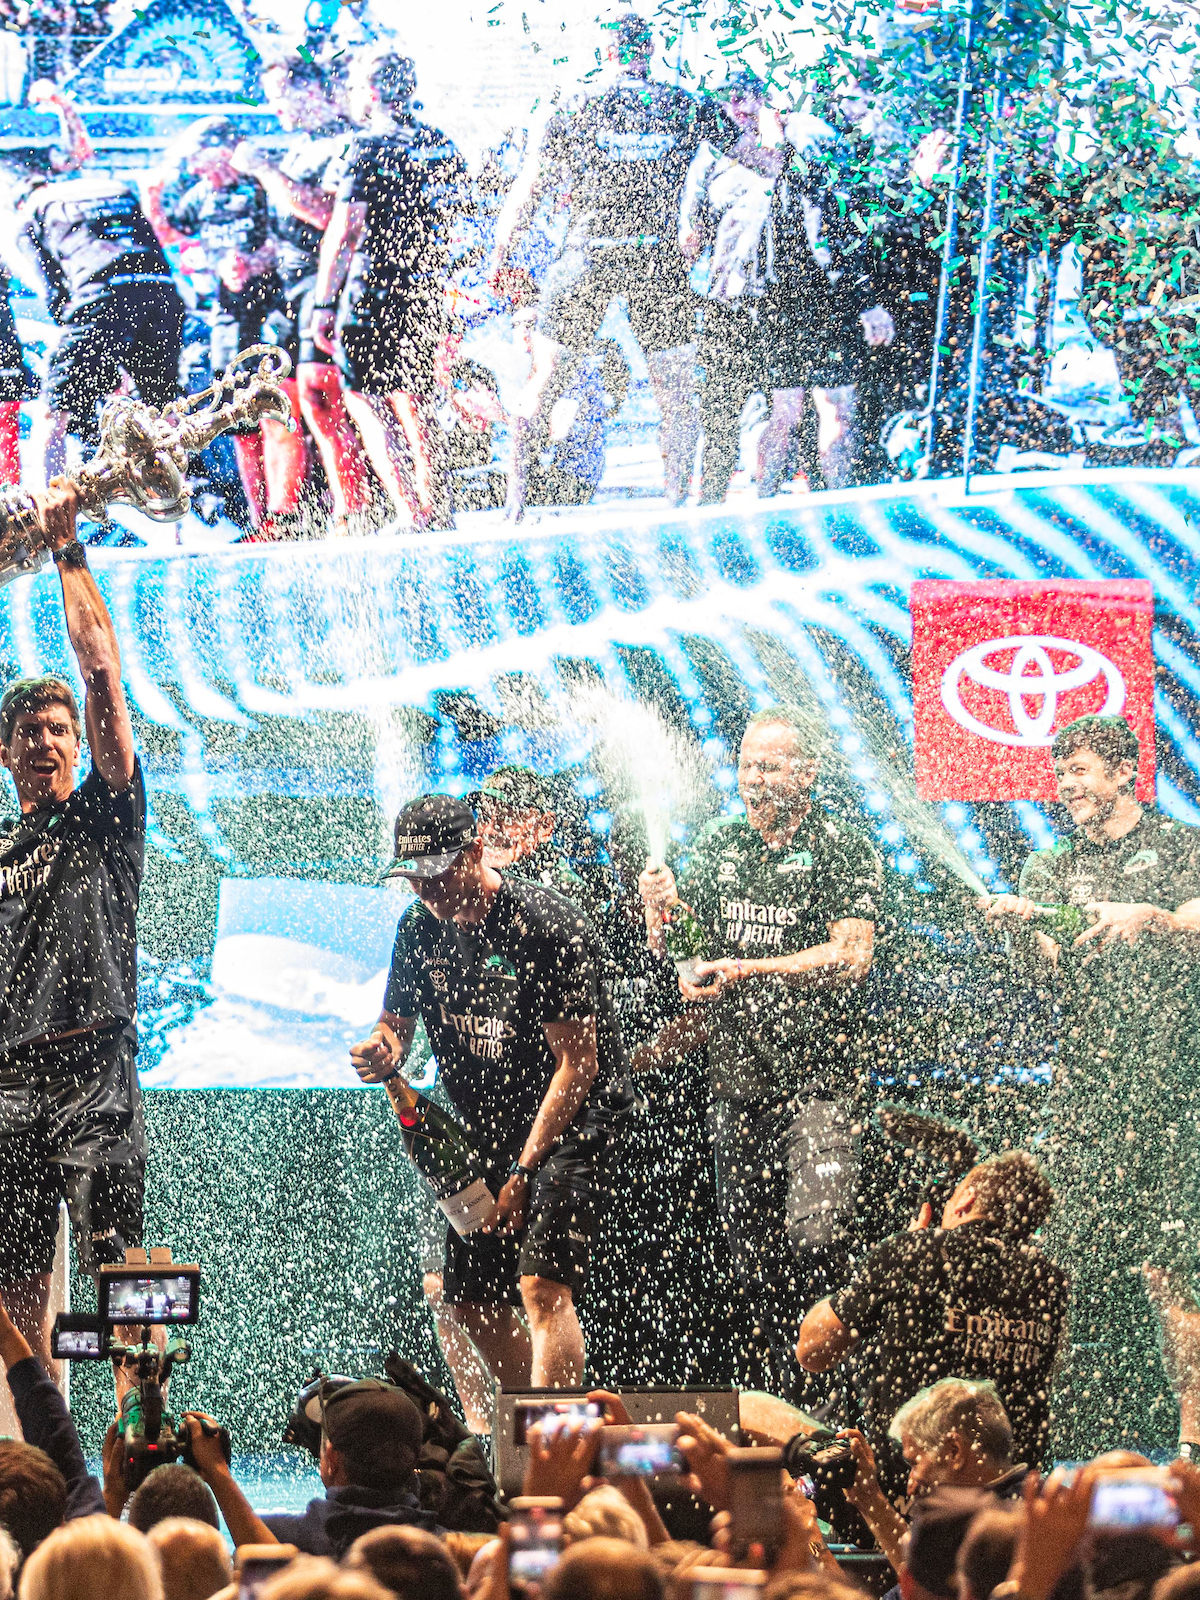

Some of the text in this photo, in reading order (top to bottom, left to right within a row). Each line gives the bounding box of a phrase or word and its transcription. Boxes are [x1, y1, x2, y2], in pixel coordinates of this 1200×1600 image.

[398, 834, 432, 845] Emirates
[719, 896, 799, 926] Emirates
[726, 921, 784, 945] FLY BETTER
[439, 1002, 518, 1039] Emirates
[469, 1037, 504, 1060] BETTER
[945, 1306, 1055, 1344] Emirates
[994, 1341, 1041, 1366] BETTER
